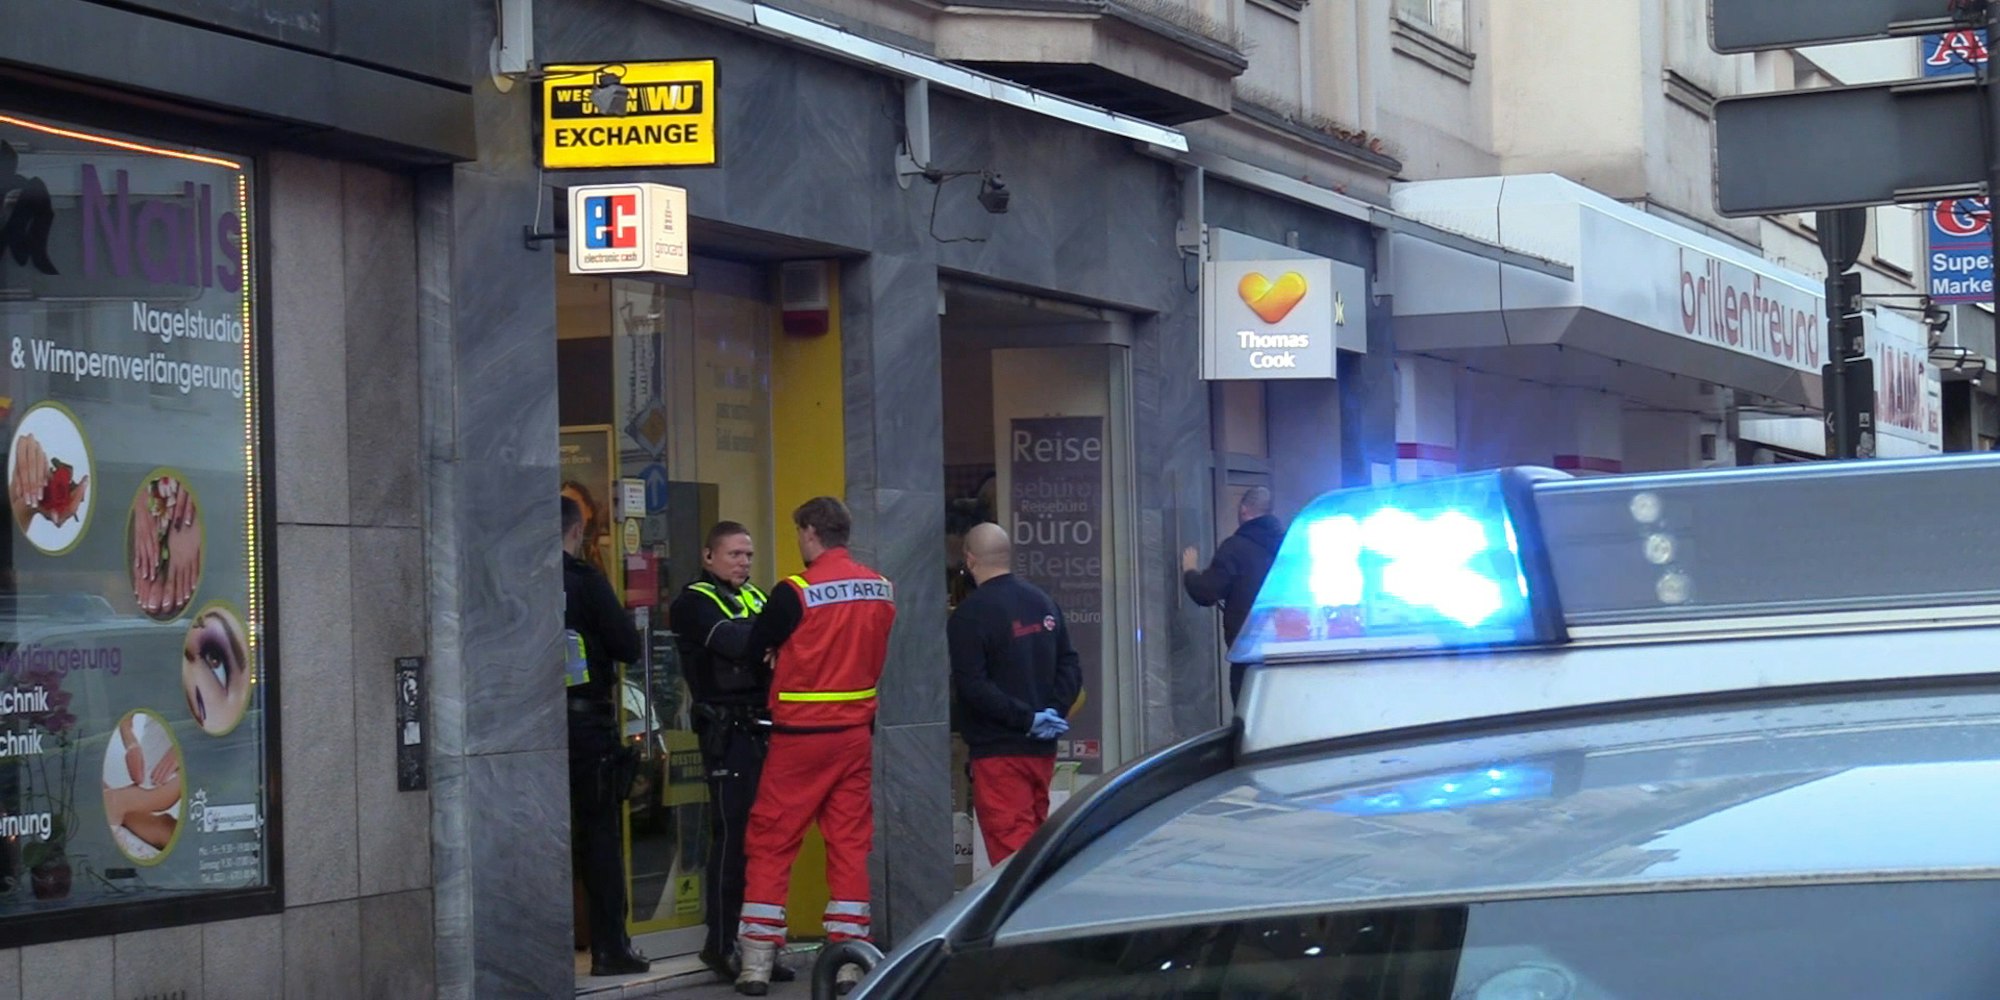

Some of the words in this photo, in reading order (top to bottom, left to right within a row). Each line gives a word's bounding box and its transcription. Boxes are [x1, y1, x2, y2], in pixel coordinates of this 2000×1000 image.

[557, 87, 638, 103] WESN
[646, 85, 695, 112] WU
[555, 124, 698, 147] EXCHANGE
[82, 163, 243, 293] Nails
[1931, 252, 1994, 272] Supe
[1679, 246, 1820, 370] brillenfreund
[133, 301, 243, 343] Nagelstudio
[1237, 331, 1309, 348] Thomas
[11, 336, 25, 369] &
[30, 338, 244, 399] Wimpernverlängerung
[1249, 351, 1296, 368] Cook
[1013, 429, 1101, 462] Reise
[1013, 510, 1093, 545] büro
[1029, 551, 1101, 577] Reise
[808, 582, 890, 603] NOTARZT
